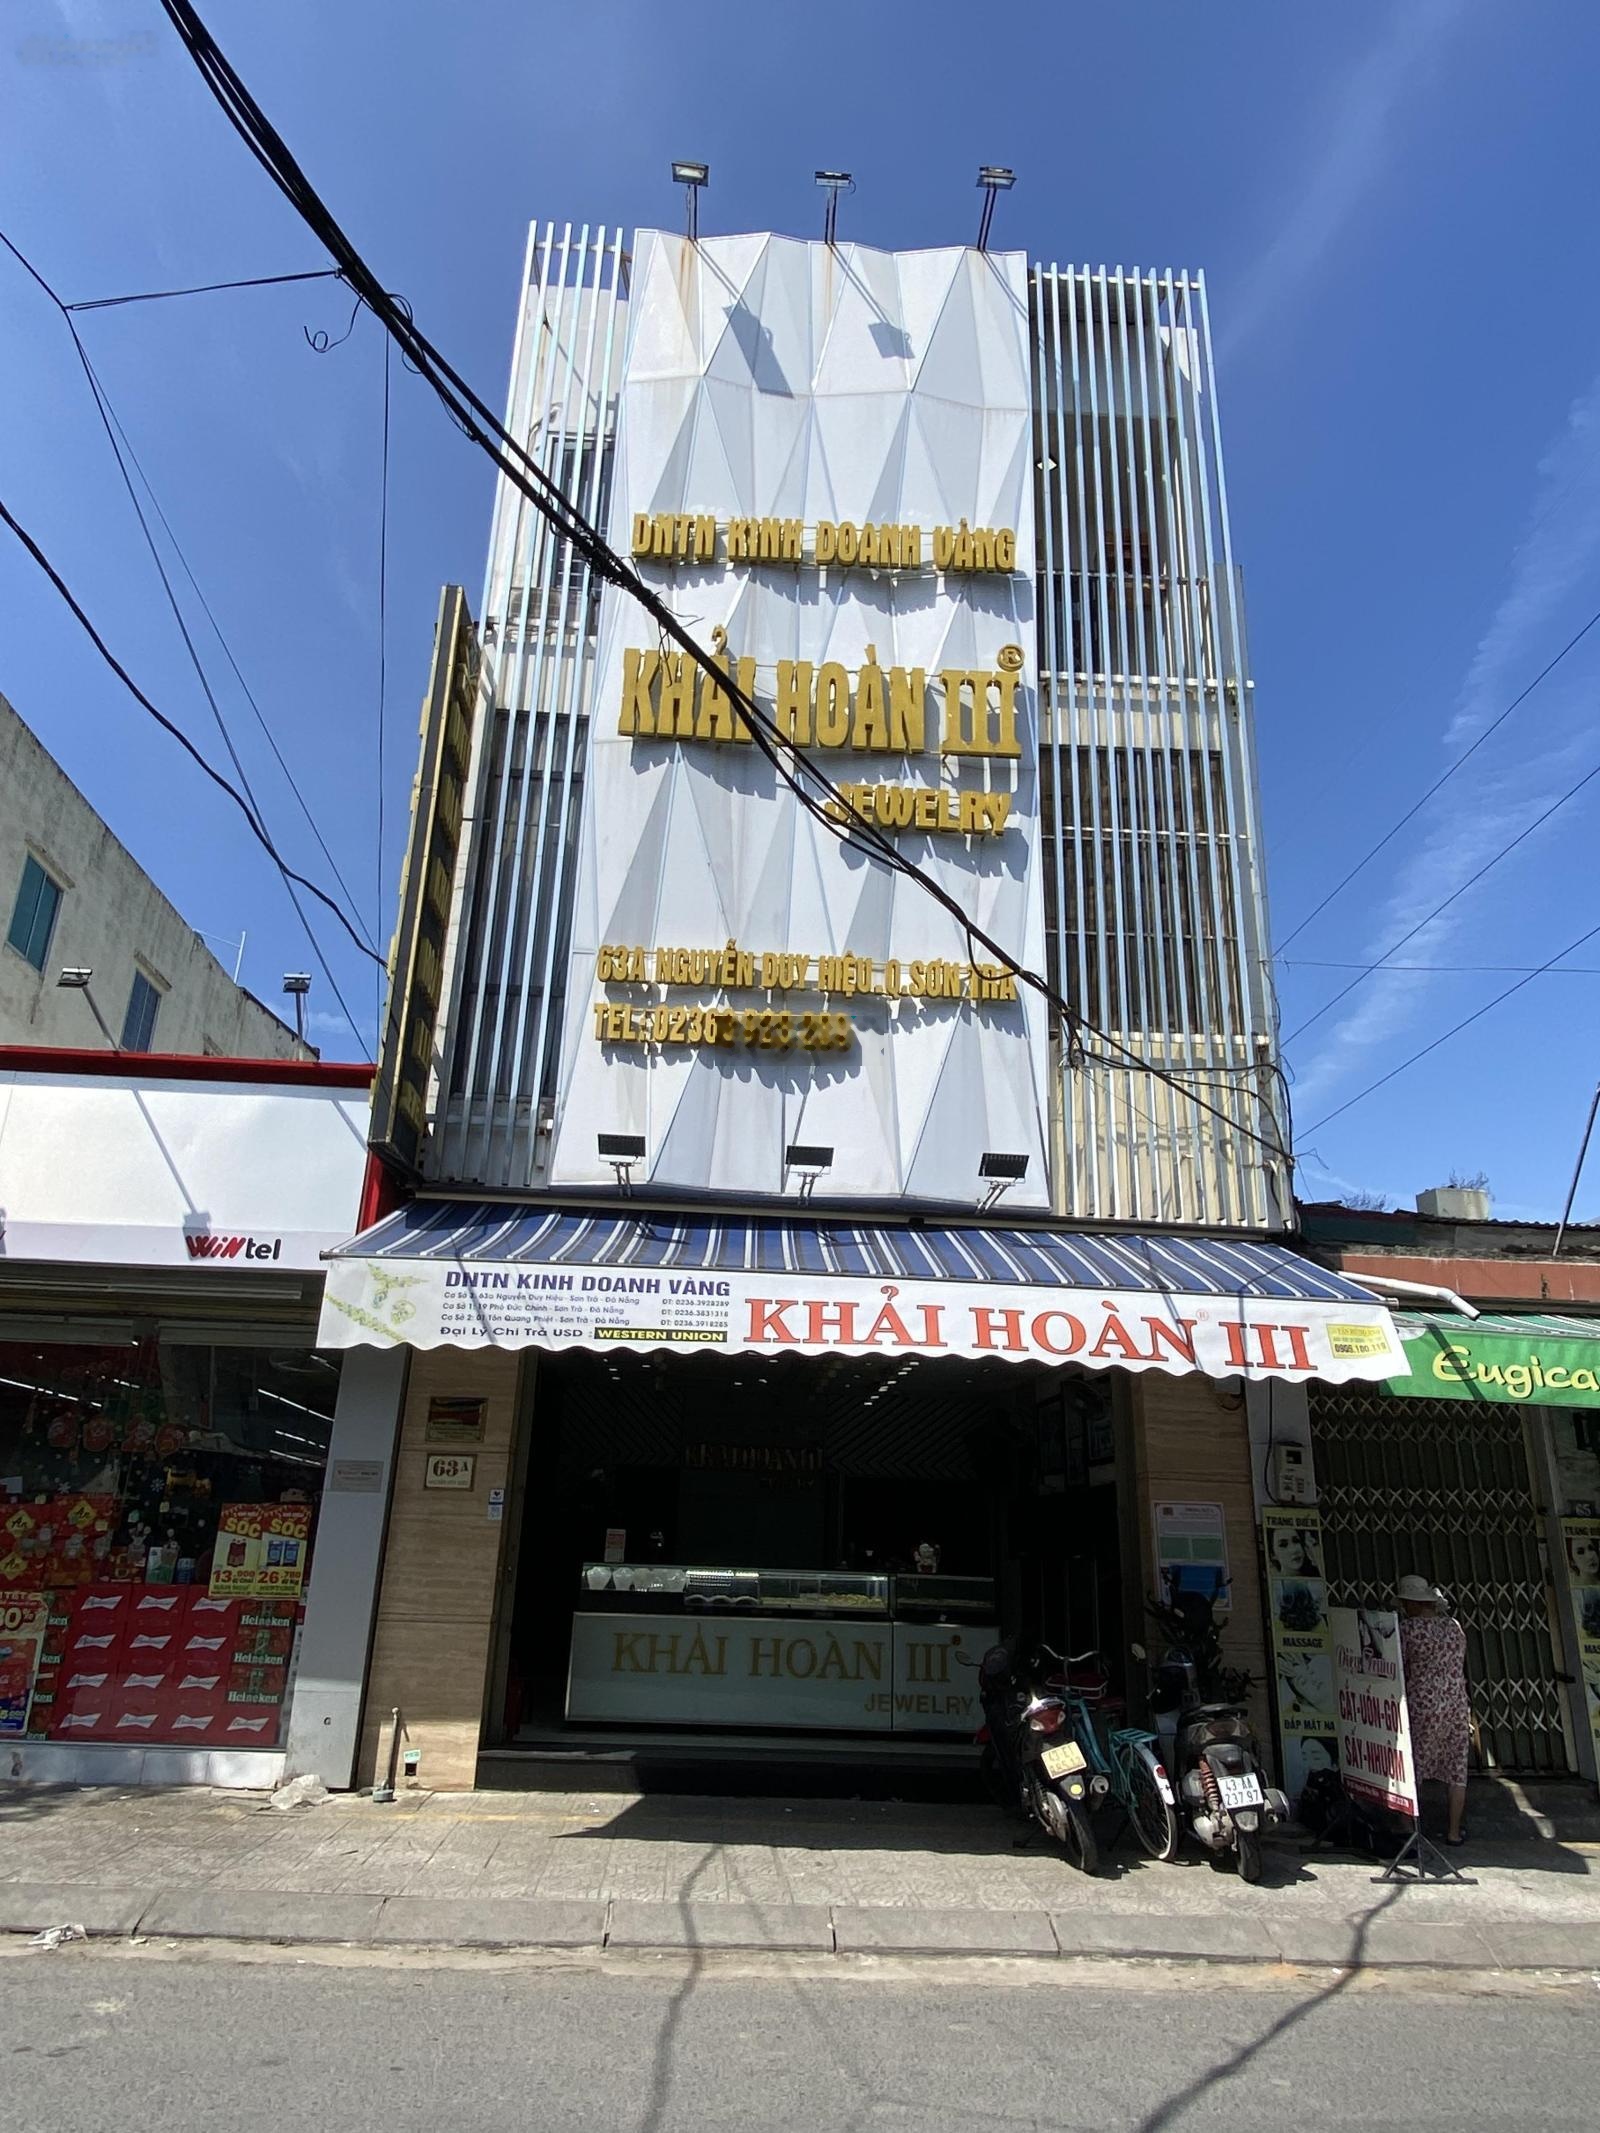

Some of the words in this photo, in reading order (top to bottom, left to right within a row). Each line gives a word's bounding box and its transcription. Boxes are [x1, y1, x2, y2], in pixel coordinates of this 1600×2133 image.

[631, 512, 716, 560] DNTN
[726, 515, 803, 564] KINH
[815, 519, 921, 569] DOANH
[933, 517, 1016, 573] VÀNG
[618, 623, 757, 744] KHẢI
[774, 643, 926, 755] HOÀN
[940, 668, 1022, 759] III
[825, 781, 1012, 837] JEWELRY
[597, 944, 647, 983] 63A
[654, 937, 756, 987] NGUYỄN
[761, 951, 811, 991] DUY
[445, 1271, 510, 1290] DNTN
[516, 1273, 574, 1291] KINH
[581, 1275, 661, 1295] DOANH
[669, 1276, 731, 1297] VÀNG
[439, 1326, 466, 1337] Đại
[492, 1327, 519, 1336] Chi
[553, 1328, 583, 1337] USD
[597, 1329, 667, 1340] WESTERN
[671, 1331, 724, 1341] UNION
[741, 1286, 950, 1348] KHẢI
[967, 1300, 1198, 1365] HOÀN
[1217, 1321, 1318, 1371] III
[748, 1630, 883, 1681] HOÀN
[905, 1642, 952, 1683] III
[1282, 1637, 1323, 1649] MASSAGE
[864, 1694, 975, 1717] JEWELRY
